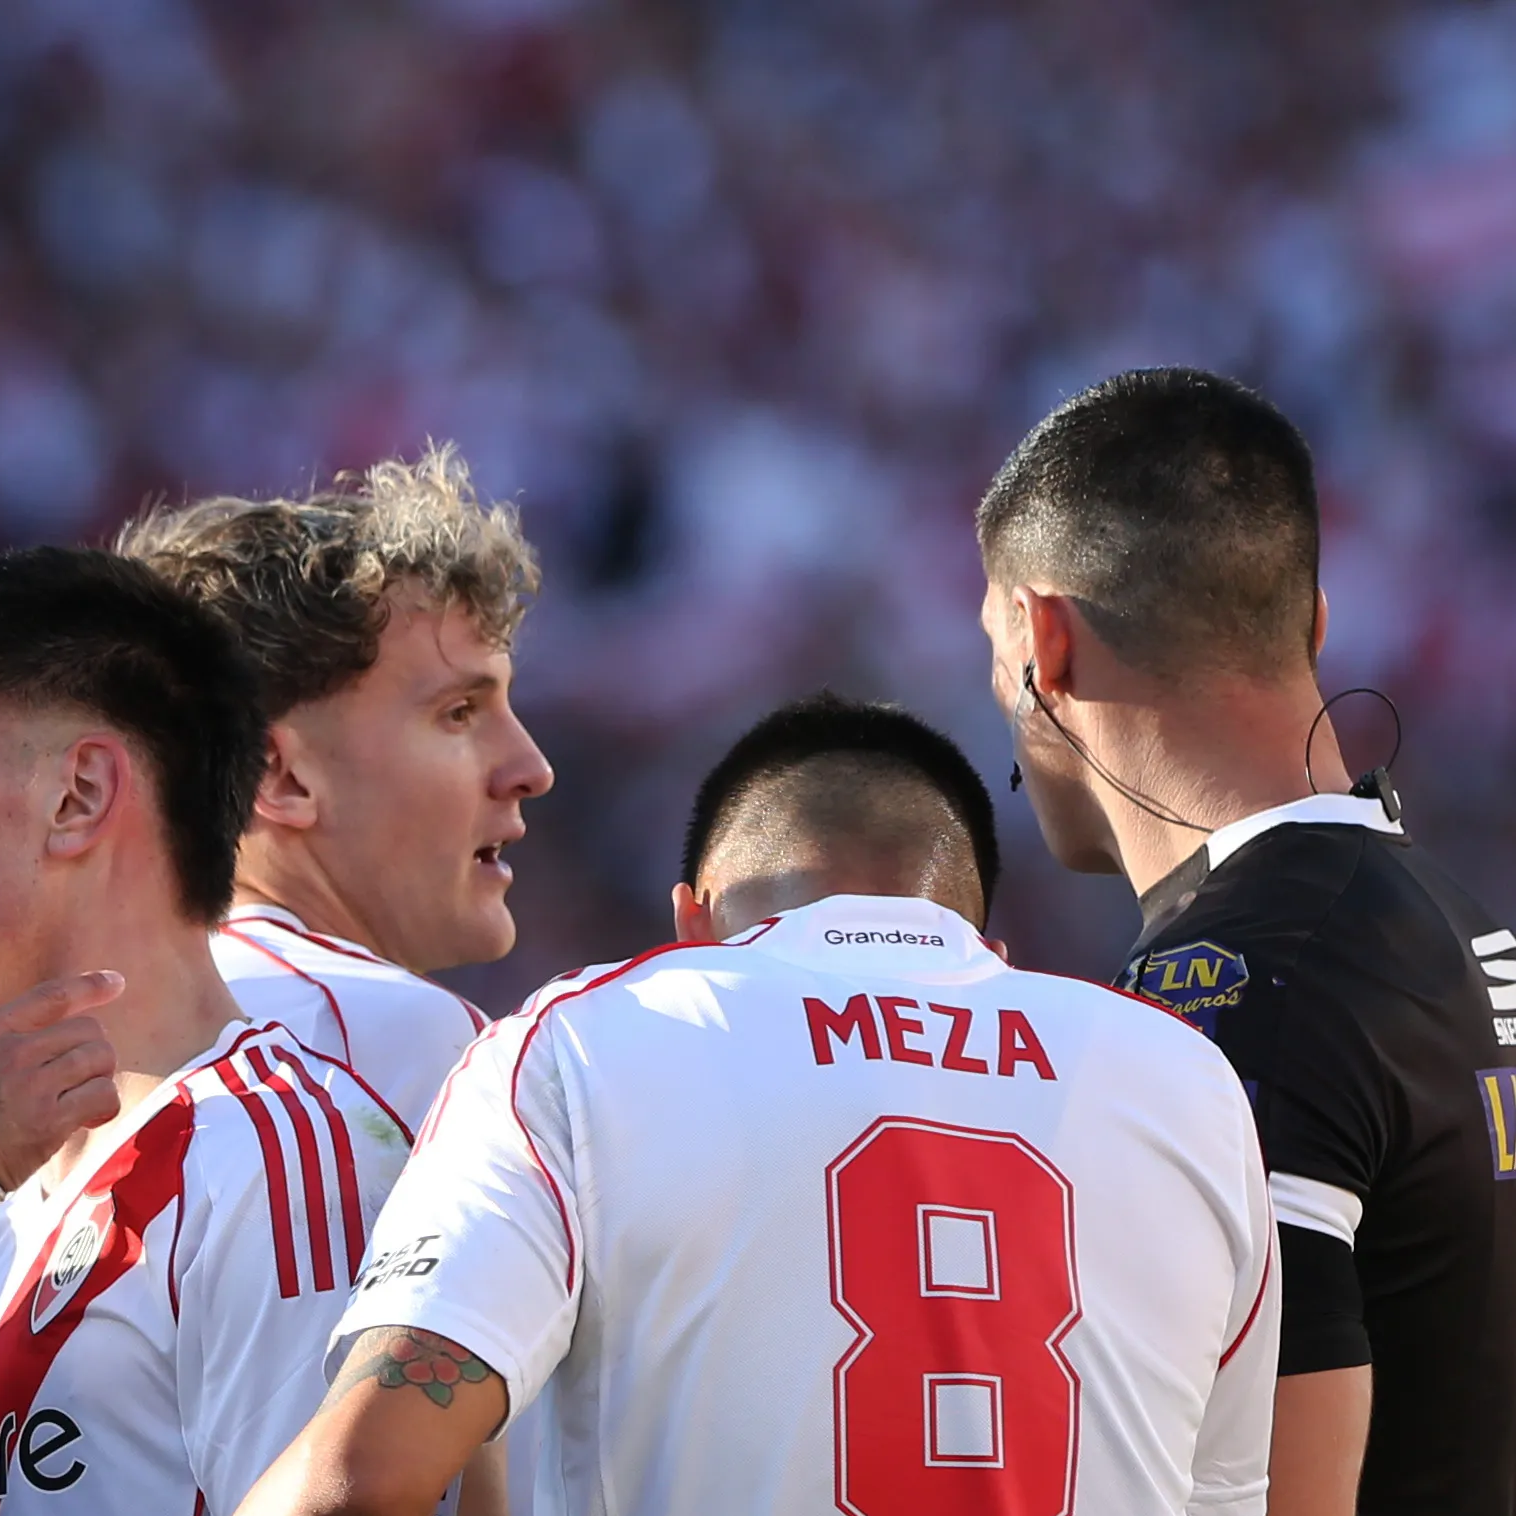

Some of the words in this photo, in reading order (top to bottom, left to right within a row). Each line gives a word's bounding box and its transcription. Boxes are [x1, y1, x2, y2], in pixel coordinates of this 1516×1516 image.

[824, 929, 945, 947] Grandeza
[1160, 958, 1224, 992] LN
[802, 993, 1058, 1081] MEZA
